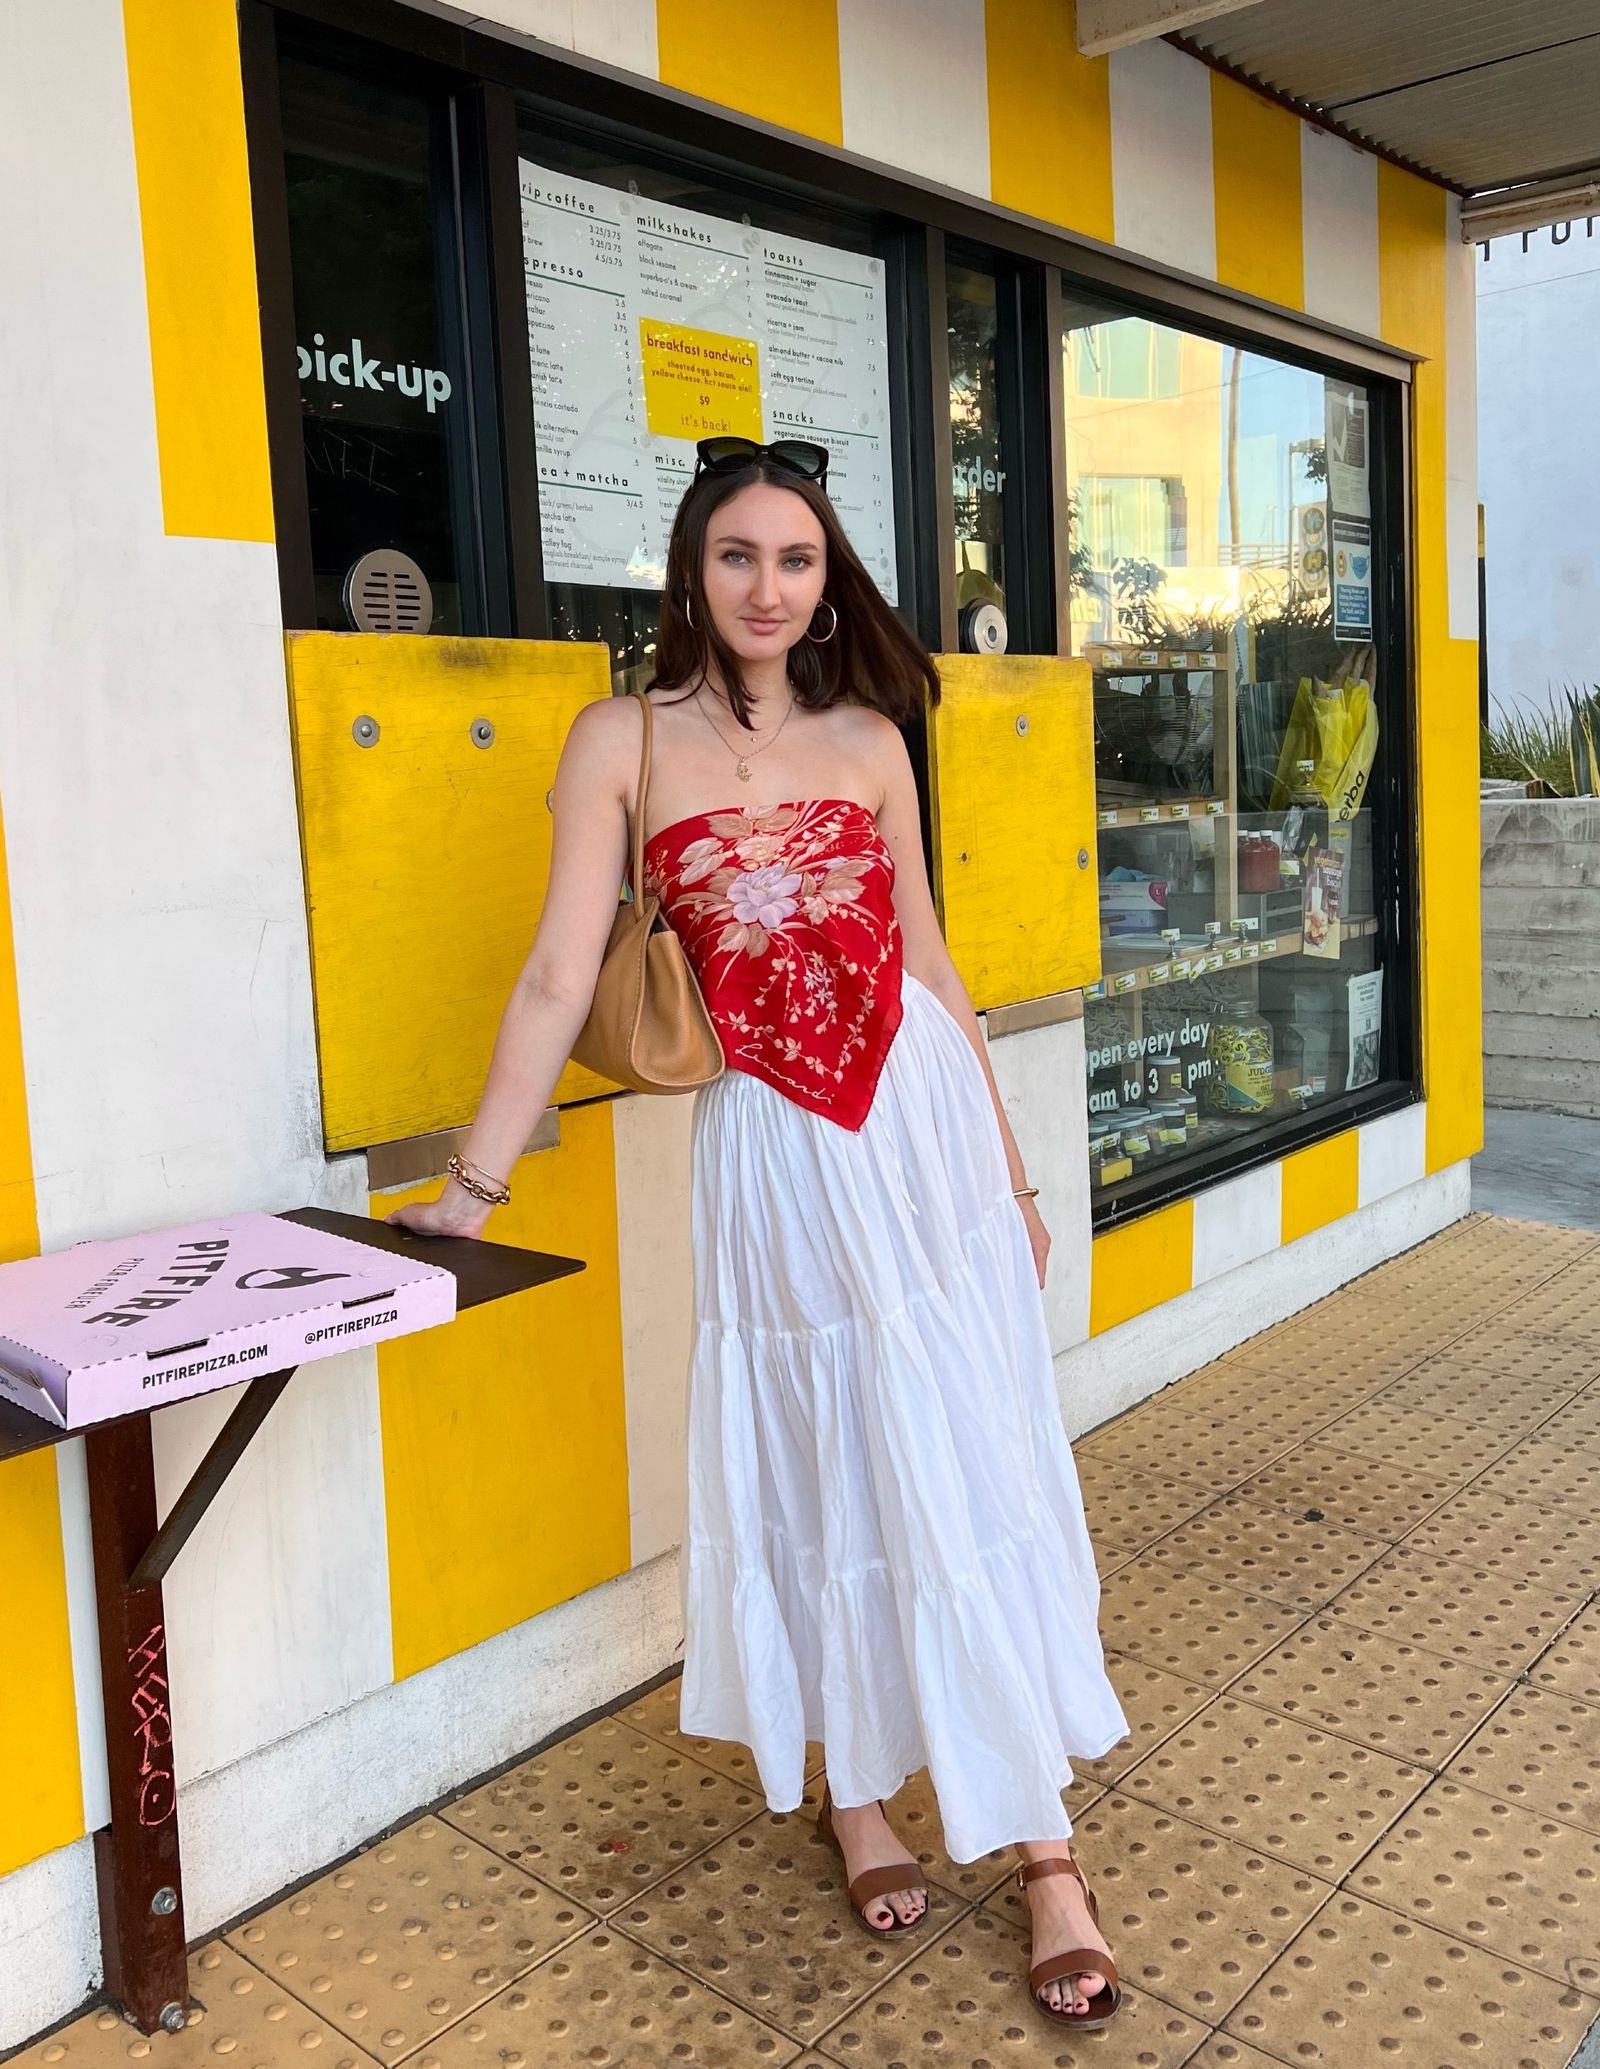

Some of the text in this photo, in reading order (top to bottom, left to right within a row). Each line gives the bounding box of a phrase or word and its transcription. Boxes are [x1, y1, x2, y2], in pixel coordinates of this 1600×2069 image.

[546, 192, 596, 213] coffee
[636, 216, 712, 243] milkshakes
[639, 254, 654, 266] black
[656, 260, 676, 270] sesame
[764, 248, 804, 266] toasts
[680, 282, 698, 291] cream
[764, 269, 794, 282] cinnamon
[800, 278, 817, 288] sugar
[641, 288, 658, 298] salted
[660, 292, 682, 302] caramel
[766, 292, 792, 304] avocado
[793, 297, 808, 306] toast
[767, 318, 786, 328] ricotta
[792, 322, 804, 332] jam
[646, 333, 700, 356] breakfast
[704, 348, 753, 367] sandwich
[768, 344, 792, 356] almond
[792, 350, 810, 360] butter
[834, 357, 844, 366] nib
[652, 368, 675, 379] yellow
[718, 381, 736, 390] sauce
[770, 371, 782, 379] soft
[782, 374, 794, 383] egg
[795, 376, 814, 386] tartine
[554, 400, 578, 413] cortado
[699, 395, 710, 406] $9
[681, 414, 731, 432] it's back!
[772, 410, 814, 424] snacks
[542, 423, 579, 436] alternatives
[774, 429, 806, 440] vegetarian
[806, 434, 830, 445] sausage
[830, 438, 849, 446] biscuit
[554, 449, 571, 458] syrup
[655, 454, 686, 467] misc.
[576, 472, 629, 487] matcha
[658, 476, 675, 486] vitality
[952, 456, 1006, 494] rder
[1086, 1018, 1210, 1077] pen every day
[1089, 1059, 1212, 1113] am to 3 pm
[107, 1258, 144, 1276] PIZZA
[81, 1239, 230, 1328] PITFIRE
[304, 1310, 398, 1345] @PITFIREPIZZA
[142, 1344, 268, 1389] PITFIREPIZZA.COM
